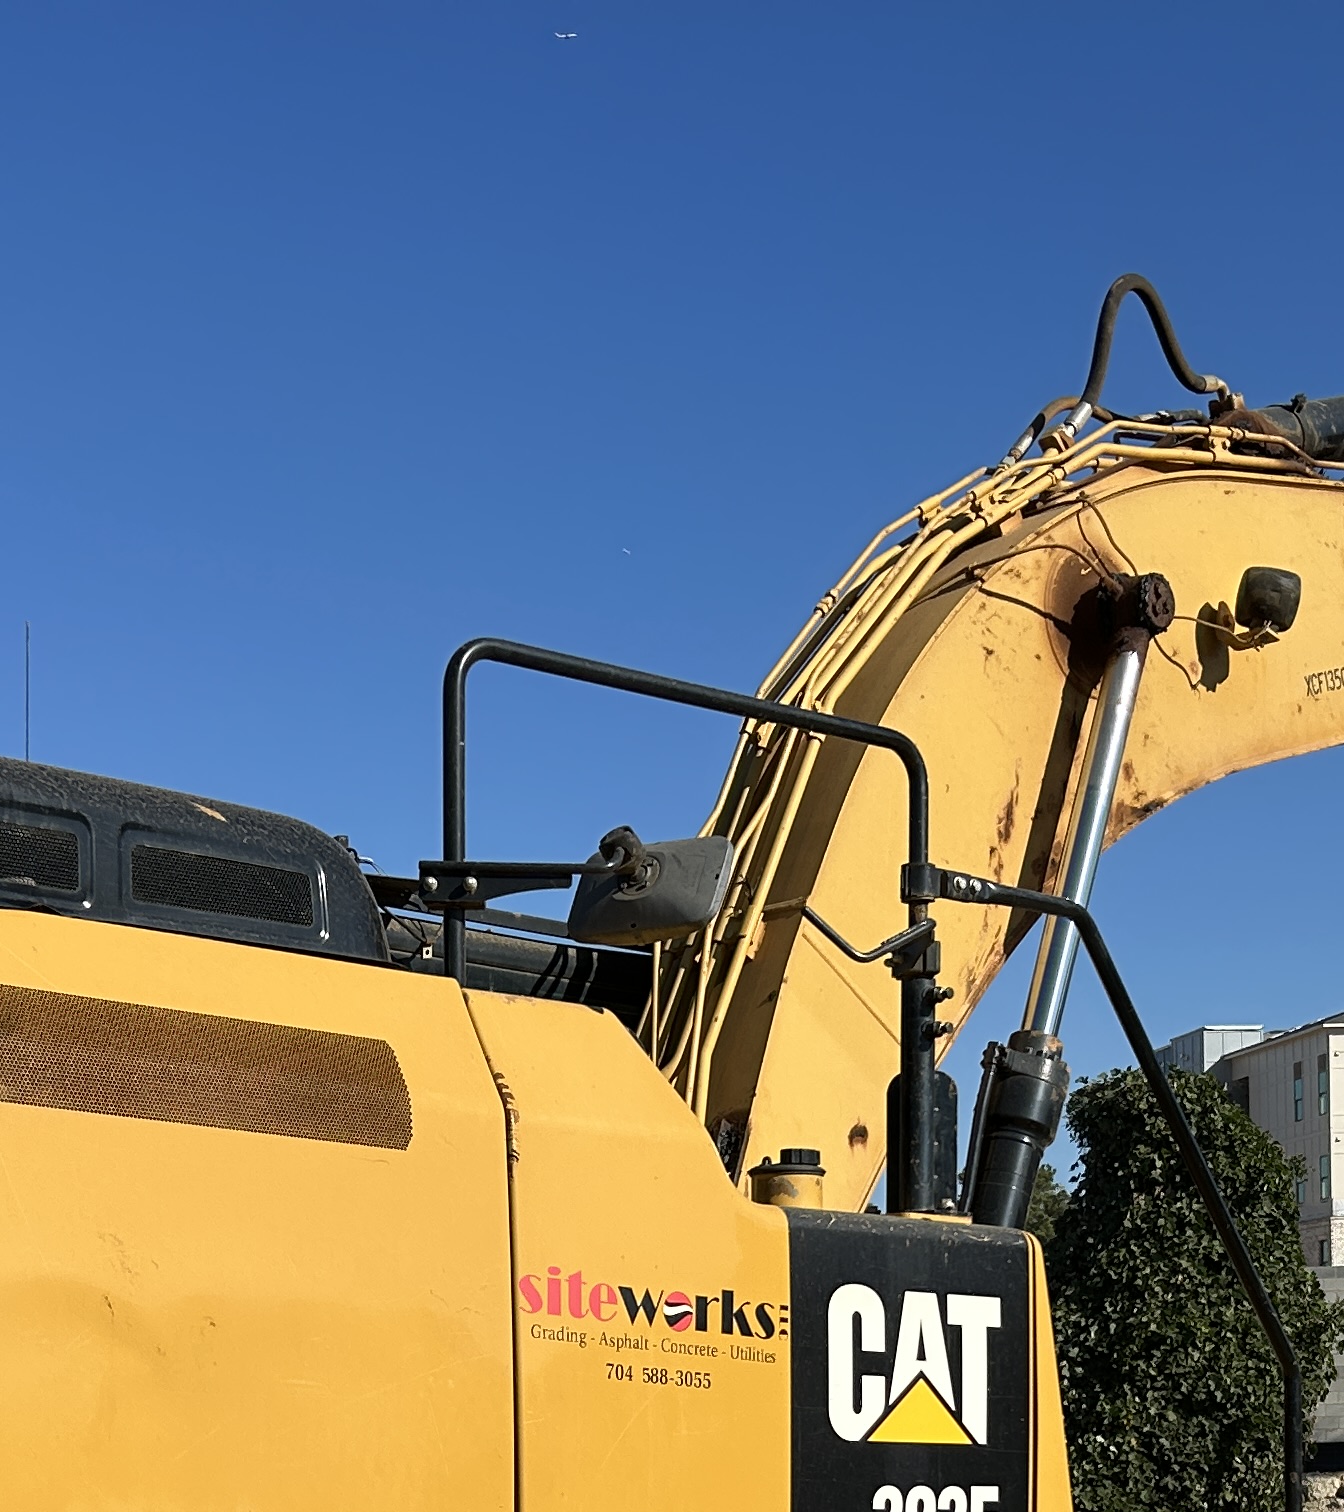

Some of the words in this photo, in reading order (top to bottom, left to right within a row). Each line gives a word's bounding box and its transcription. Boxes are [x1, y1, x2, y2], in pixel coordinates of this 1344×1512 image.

[518, 1266, 775, 1340] siteworks
[530, 1324, 587, 1348] Grading
[599, 1331, 649, 1352] Asphalt
[660, 1338, 718, 1358] Concrete
[729, 1345, 777, 1364] Utilities
[827, 1283, 1002, 1446] CAT
[606, 1363, 633, 1382] 704
[642, 1367, 712, 1390] 588-3055
